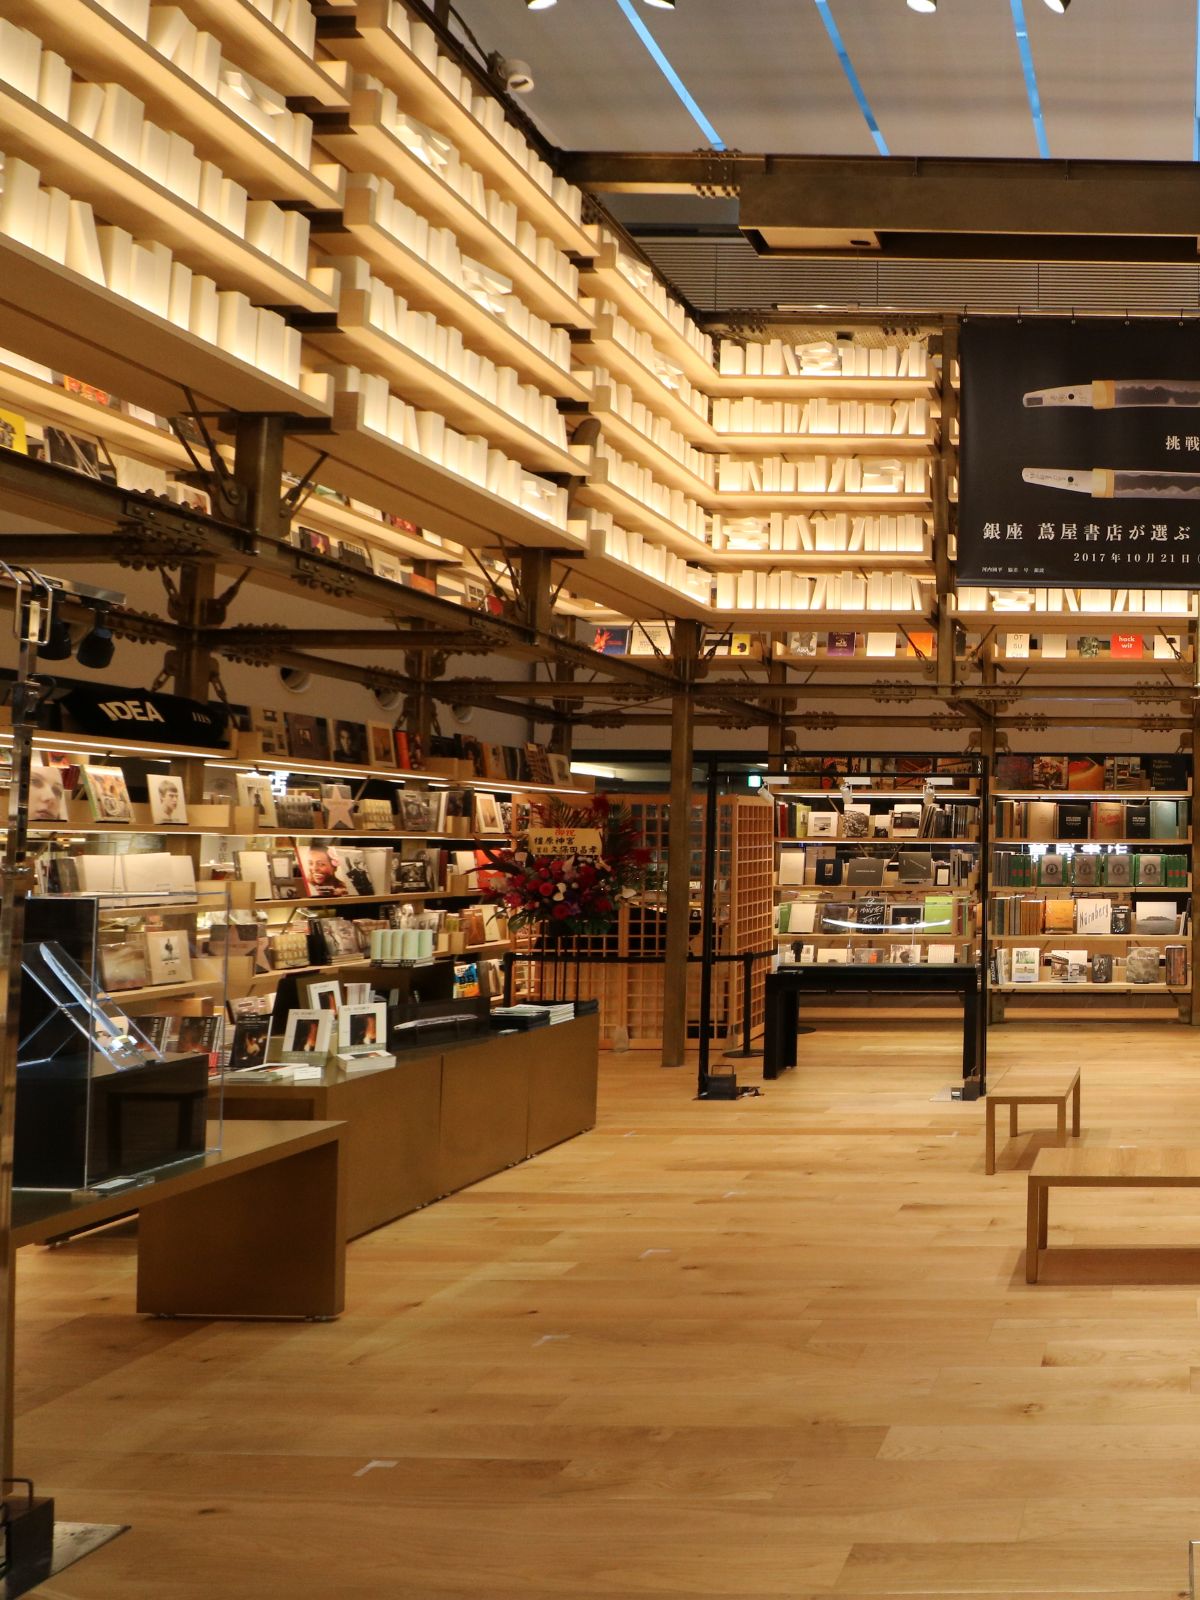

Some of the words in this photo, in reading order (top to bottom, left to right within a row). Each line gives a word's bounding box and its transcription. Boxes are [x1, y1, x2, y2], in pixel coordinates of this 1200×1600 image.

[982, 522, 1024, 541] 銀座
[1037, 522, 1191, 542] 蔦屋書店が選ぶ
[98, 700, 165, 723] IDEA
[1079, 904, 1109, 928] Nürnberg
